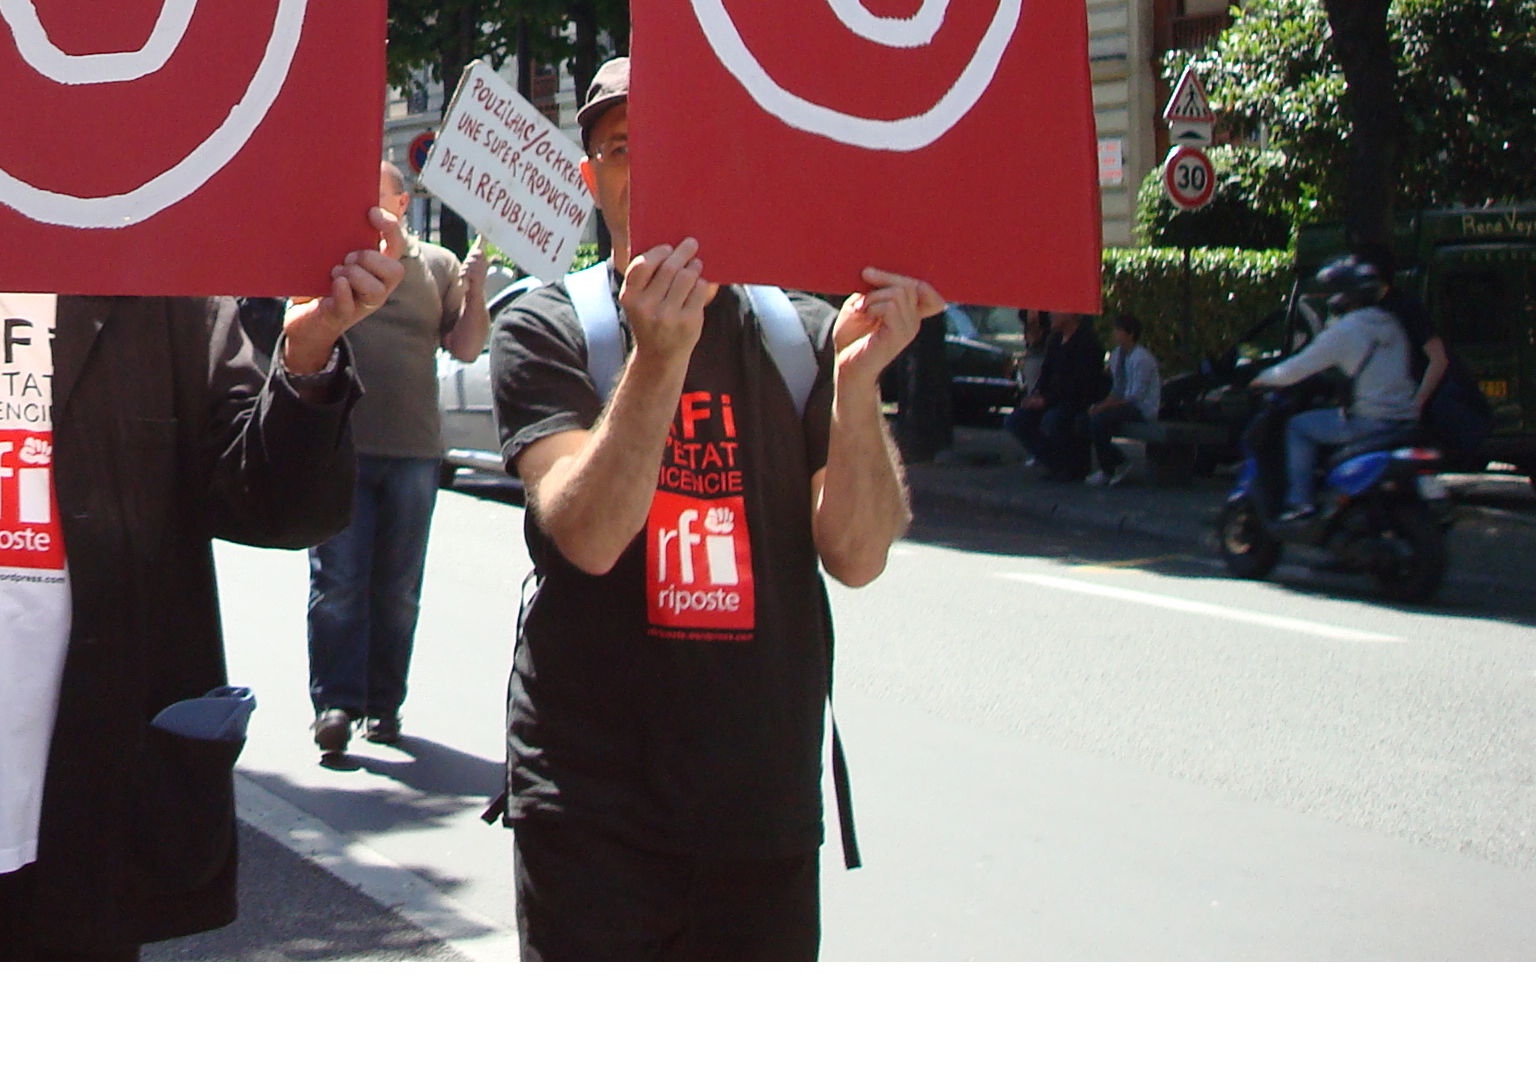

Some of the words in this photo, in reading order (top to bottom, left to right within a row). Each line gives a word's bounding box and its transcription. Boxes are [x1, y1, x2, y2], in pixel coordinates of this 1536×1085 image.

[457, 111, 484, 142] UNE
[1177, 164, 1206, 191] 30
[440, 147, 459, 174] DE
[456, 162, 474, 190] LA
[551, 237, 565, 263] !
[670, 390, 737, 439] Fi
[664, 436, 739, 470] 'ETAT
[659, 466, 744, 494] ICENCIE
[657, 506, 739, 586] rfi
[657, 583, 741, 615] riposte
